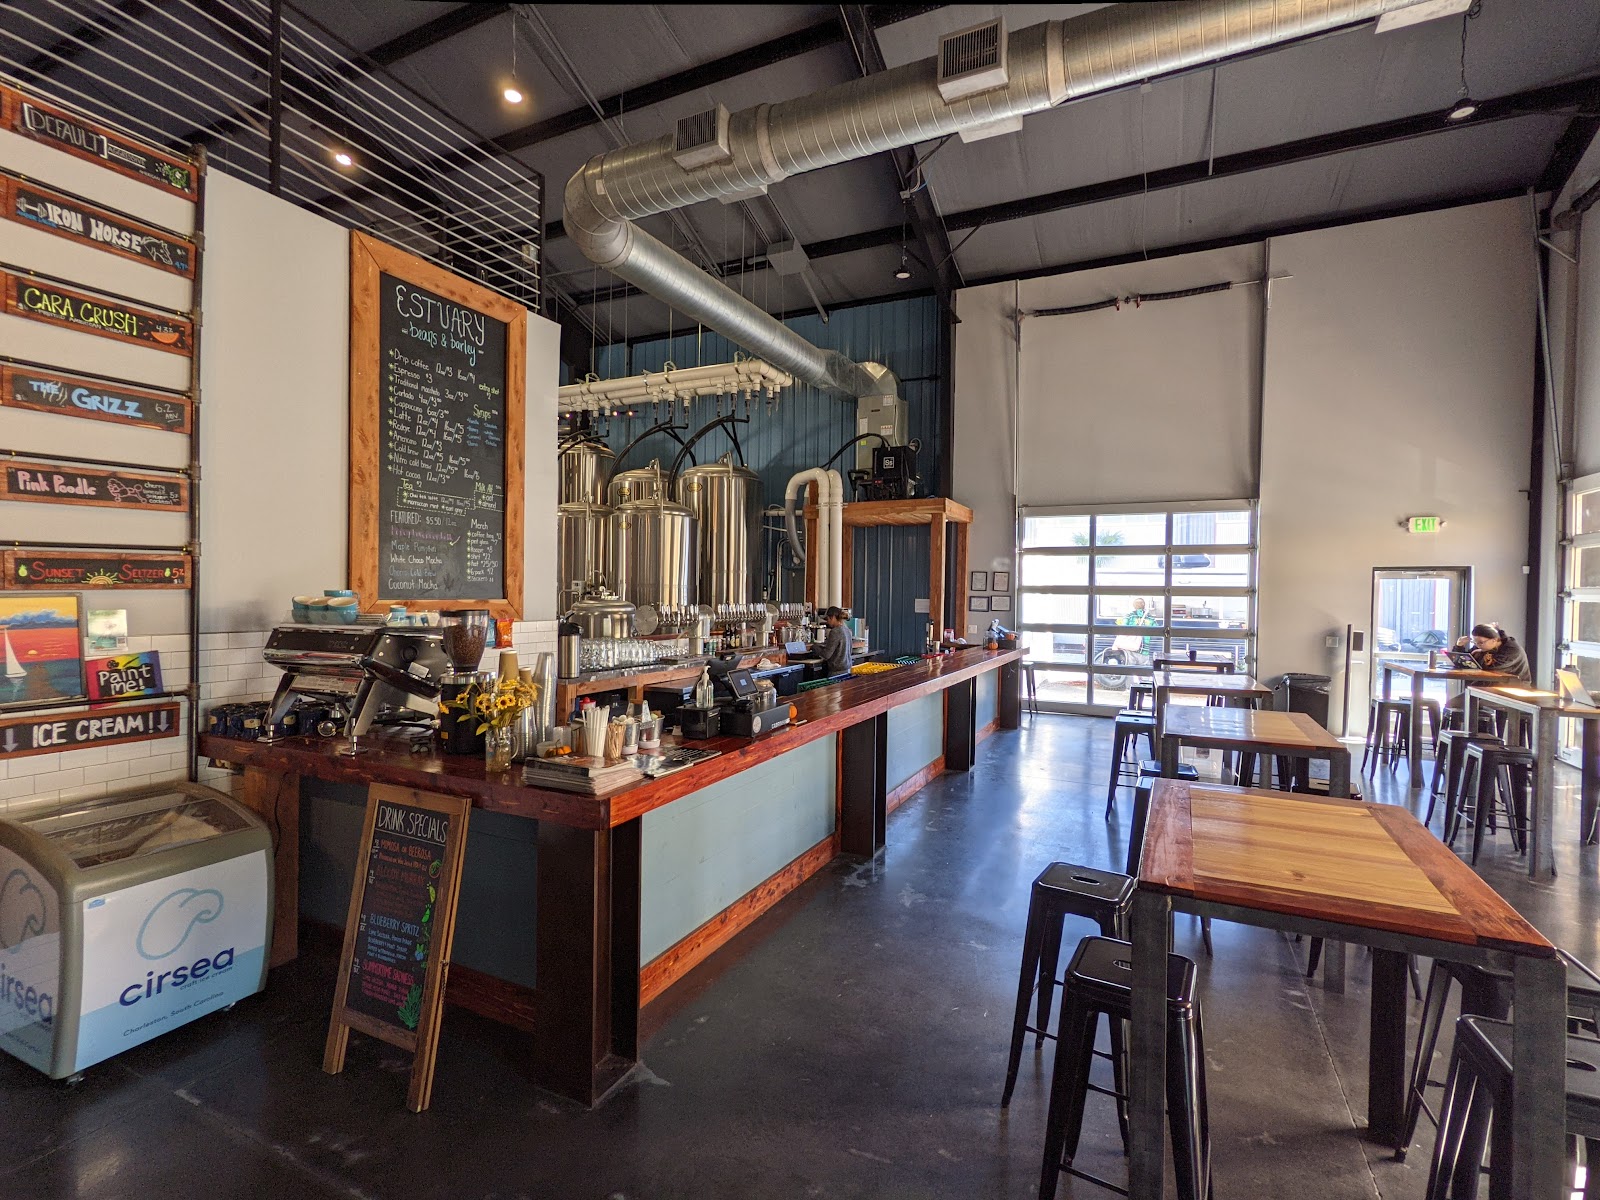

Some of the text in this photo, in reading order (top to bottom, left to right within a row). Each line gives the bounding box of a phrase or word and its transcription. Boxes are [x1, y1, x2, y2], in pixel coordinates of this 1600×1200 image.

[45, 202, 84, 232] IRON
[90, 217, 142, 253] HORSE
[24, 287, 137, 336] CARA CRUSH
[395, 285, 485, 346] ESTUARY
[394, 348, 410, 365] Drip
[410, 321, 476, 367] beans & barley
[29, 380, 143, 418] THE GRIZZ
[17, 470, 97, 496] Pink Poodle
[401, 478, 413, 490] Tea
[471, 519, 488, 530] Merch
[1415, 518, 1437, 533] EXIT
[30, 561, 85, 581] SUNSET
[118, 563, 165, 581] SELTZER
[388, 578, 438, 590] Coconut Mocha
[98, 664, 151, 696] Paint me!
[33, 722, 67, 748] ICE
[378, 805, 448, 843] DRINK SPECIALS
[370, 913, 401, 931] BLUEBERRY
[119, 947, 234, 1006] cirsea
[0, 963, 53, 1025] irsea
